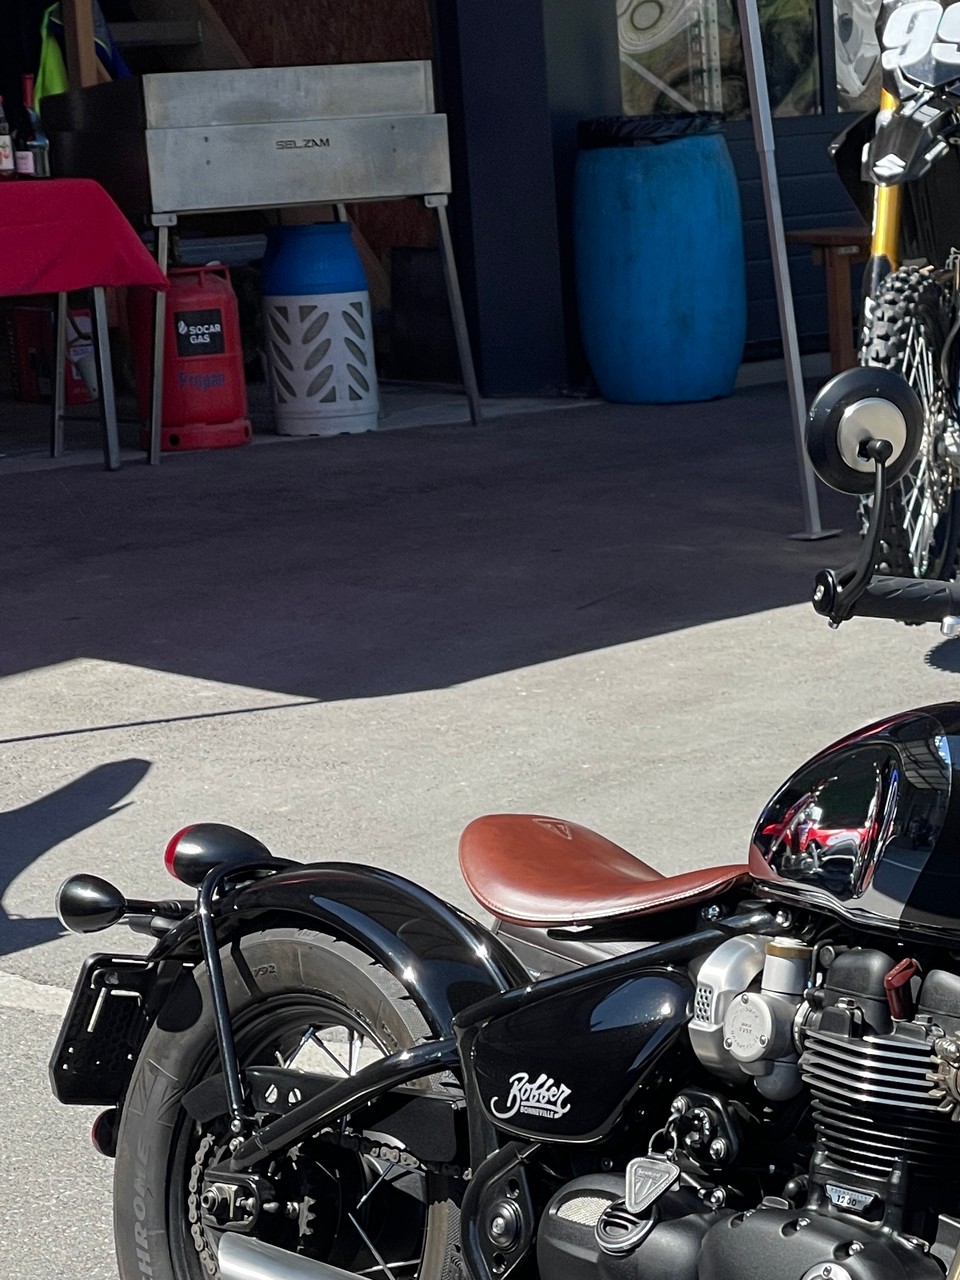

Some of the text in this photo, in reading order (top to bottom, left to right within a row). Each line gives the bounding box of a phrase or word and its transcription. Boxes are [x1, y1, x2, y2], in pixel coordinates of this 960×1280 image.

[275, 138, 330, 150] SELZAM
[189, 324, 221, 334] SOCAR
[190, 334, 210, 344] GAS
[837, 1194, 858, 1207] 1200
